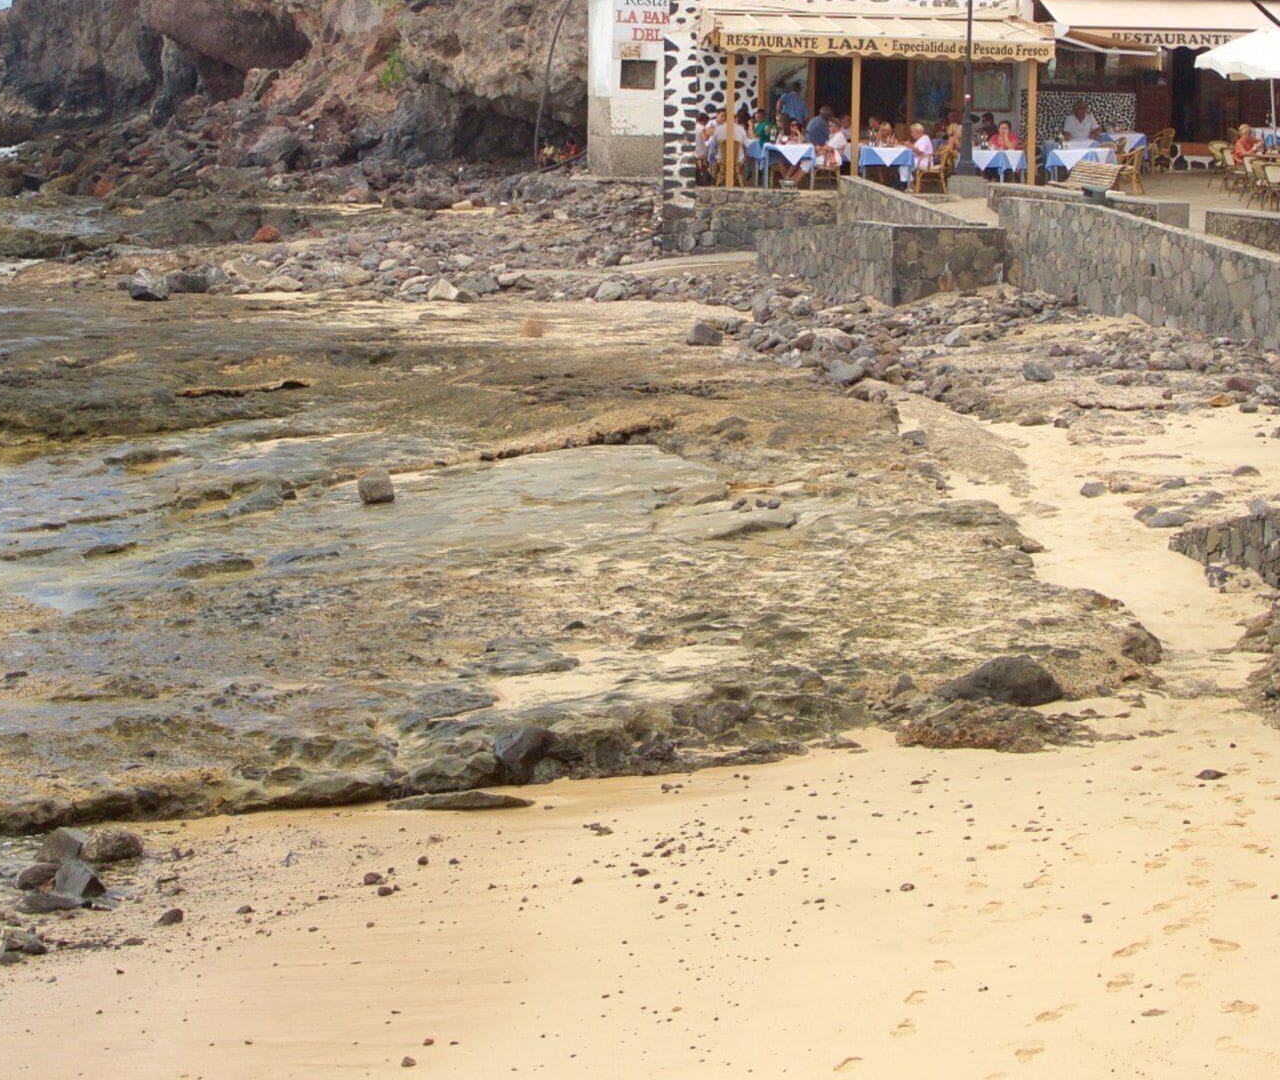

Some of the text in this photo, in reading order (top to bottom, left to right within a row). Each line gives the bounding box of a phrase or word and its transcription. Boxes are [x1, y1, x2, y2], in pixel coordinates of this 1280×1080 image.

[616, 10, 638, 24] LA
[632, 28, 664, 41] DEL
[1111, 32, 1232, 45] RESTAURANTE
[726, 34, 819, 49] RESTAURANTE
[828, 38, 879, 51] LAJA
[892, 40, 956, 53] Especialidad
[973, 43, 1013, 56] Pescado
[1016, 44, 1049, 57] Fresco
